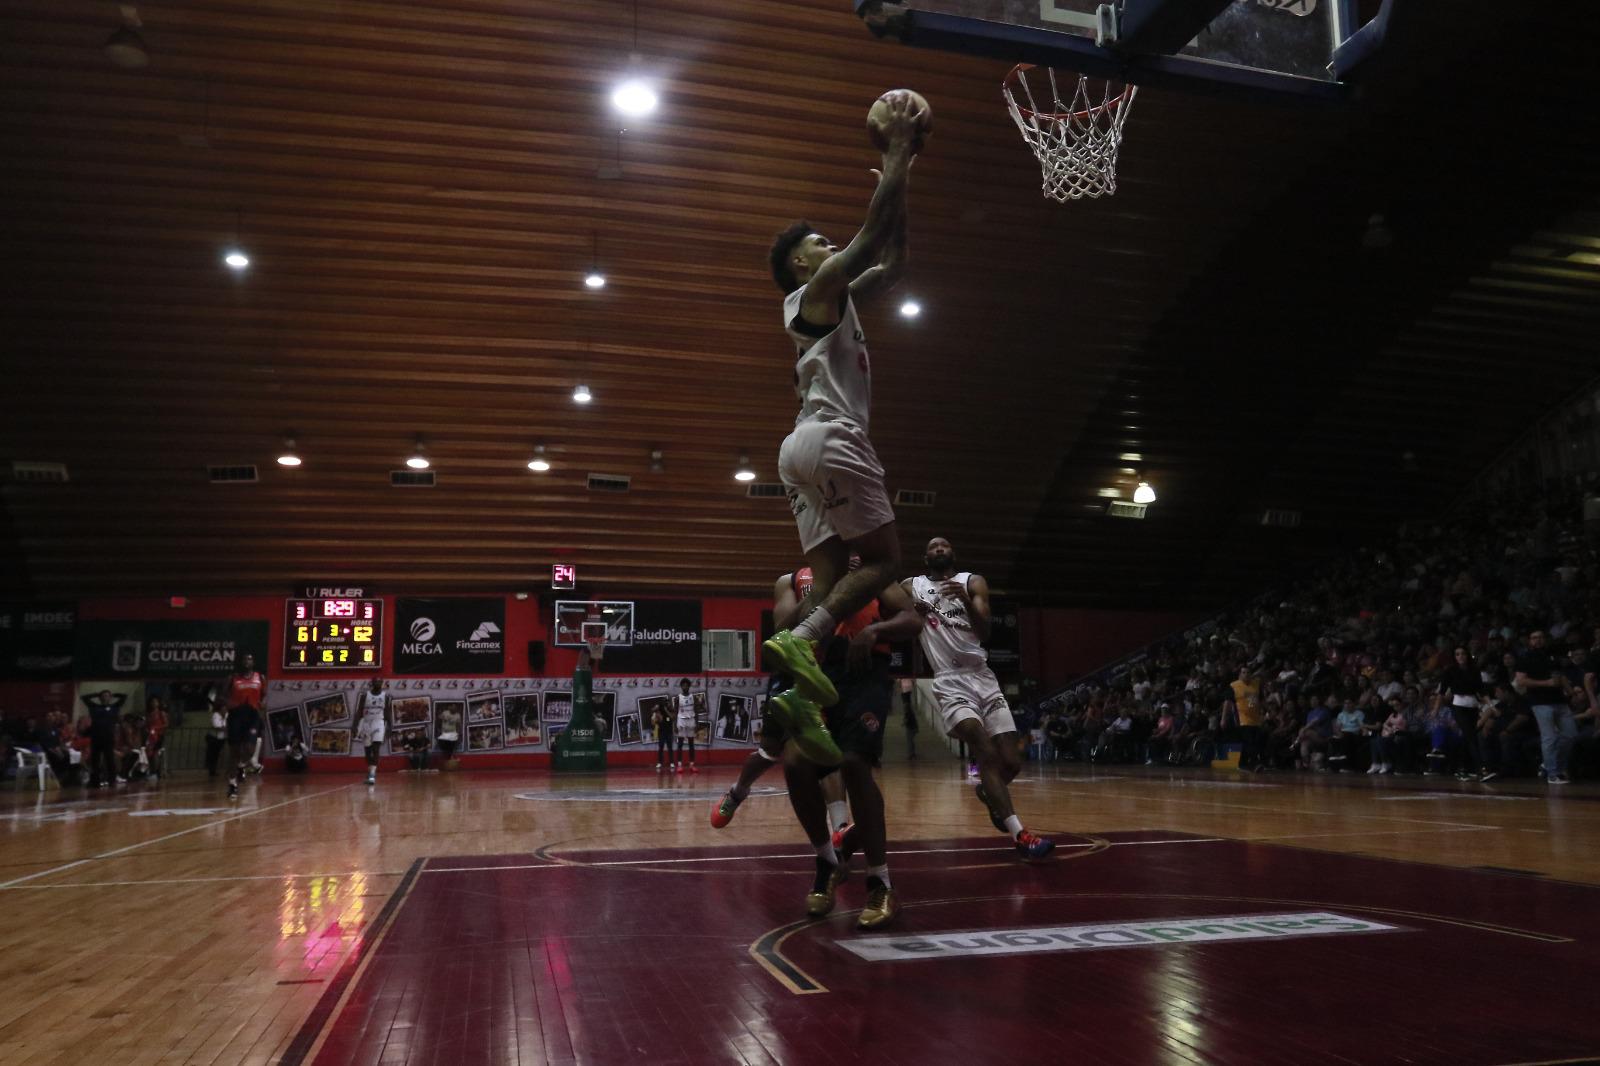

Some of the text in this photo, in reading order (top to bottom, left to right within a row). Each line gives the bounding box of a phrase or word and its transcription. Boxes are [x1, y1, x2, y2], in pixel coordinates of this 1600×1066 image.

[555, 567, 573, 581] 24
[320, 588, 363, 597] RULER
[296, 606, 305, 618] 3
[324, 601, 354, 616] 8:29
[364, 606, 373, 618] 3
[23, 612, 73, 624] IMDEC
[297, 626, 318, 642] 61
[330, 624, 339, 636] 3
[353, 626, 373, 642] 62
[149, 641, 235, 649] AYUNTAMIENTO DE
[401, 643, 443, 655] MEGA
[456, 640, 500, 649] Fincamex
[299, 649, 305, 662] 1
[363, 649, 373, 662] 0
[891, 915, 1370, 955] SaludDigna
